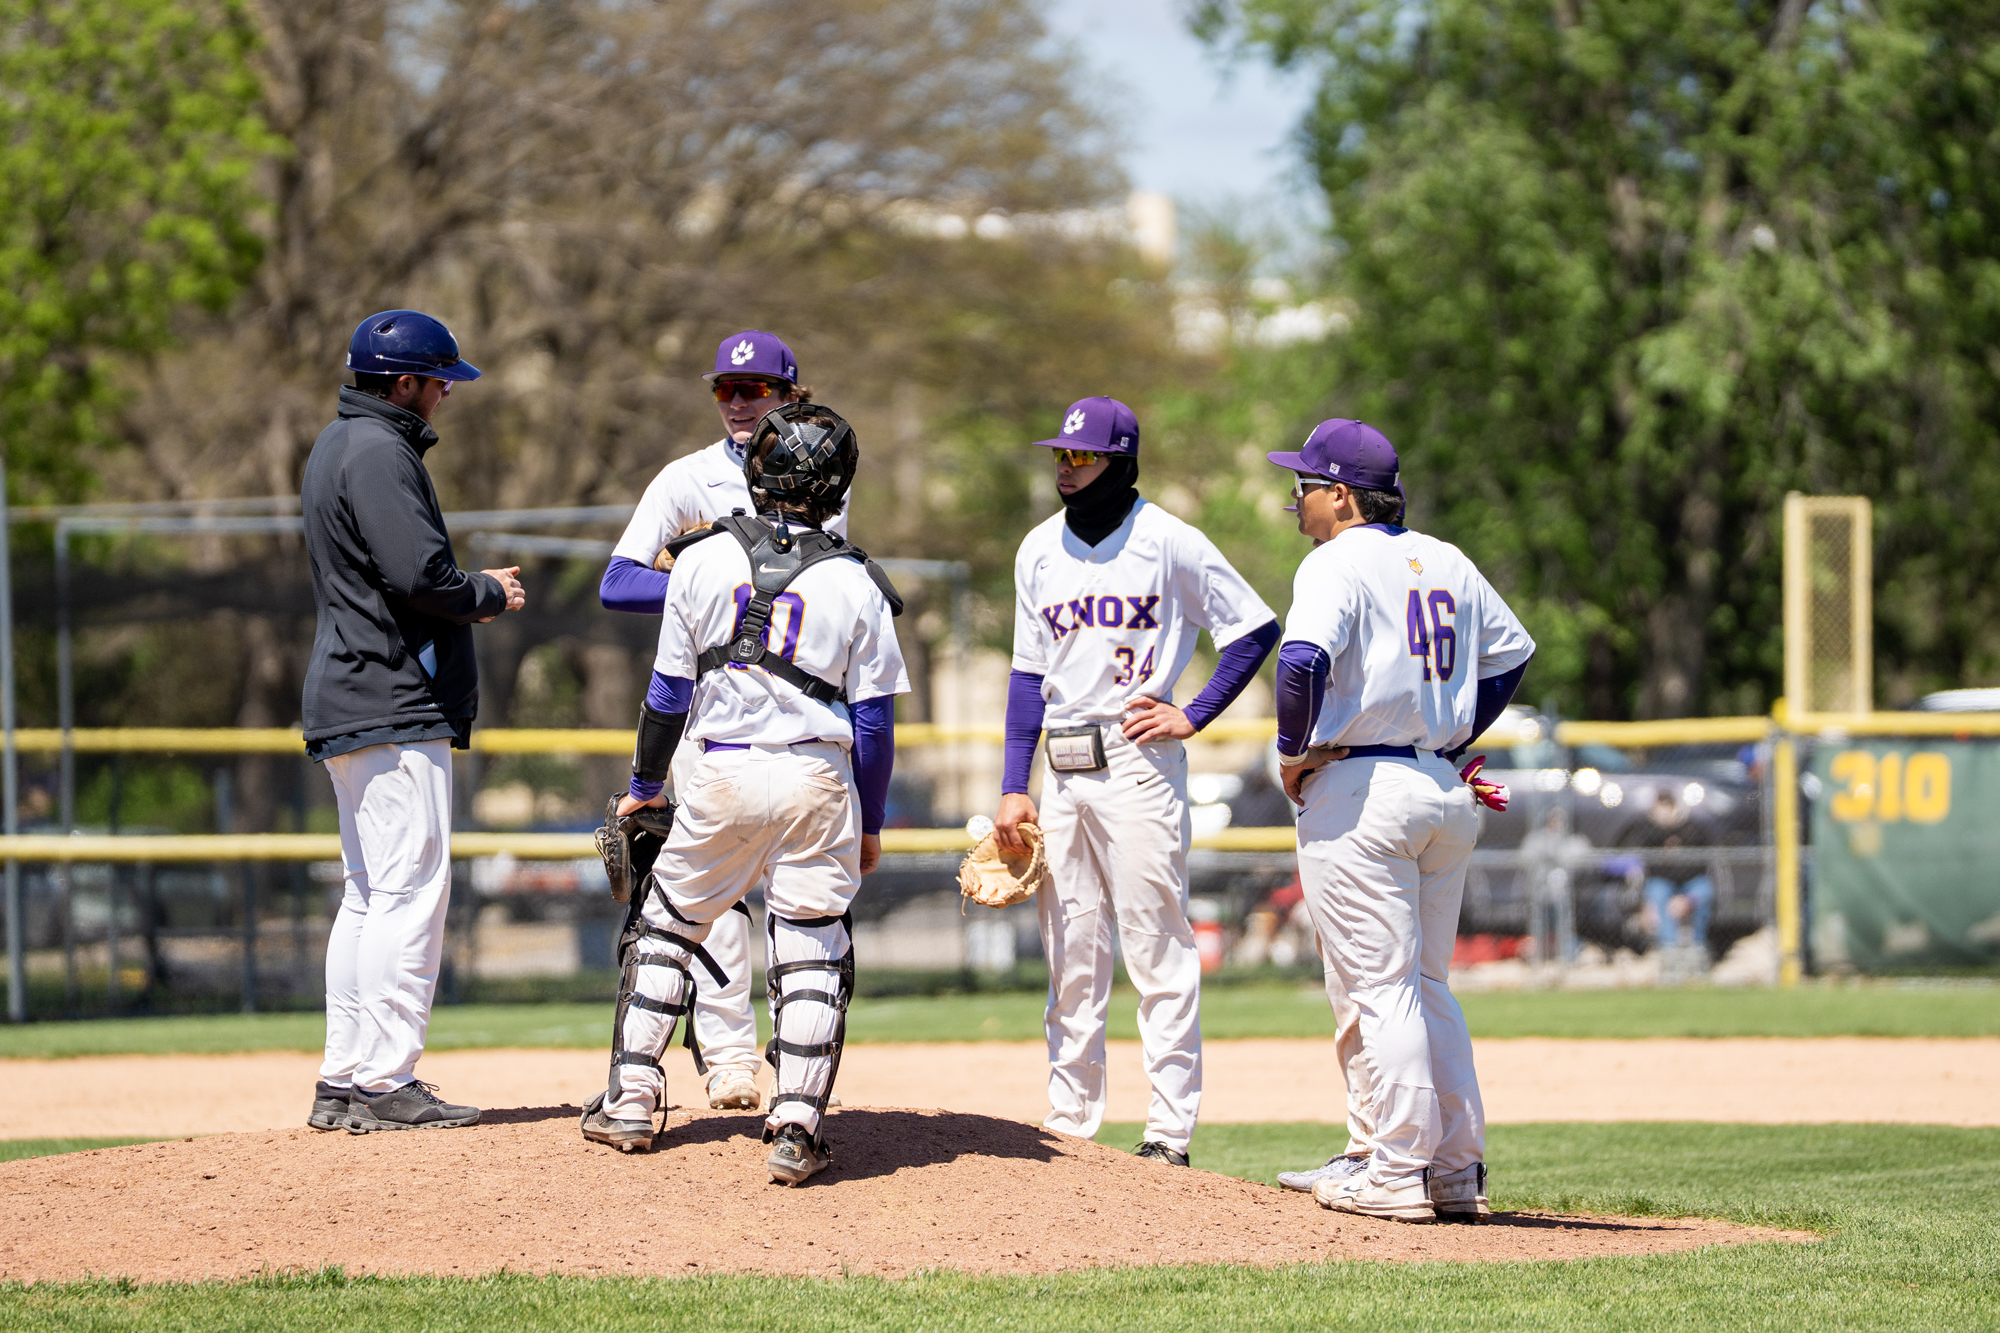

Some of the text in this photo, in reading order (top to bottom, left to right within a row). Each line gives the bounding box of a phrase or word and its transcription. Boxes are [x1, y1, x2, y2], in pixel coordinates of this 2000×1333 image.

[728, 581, 807, 679] 10
[1042, 594, 1161, 641] KNOX
[1406, 588, 1456, 682] 46
[1114, 645, 1156, 687] 34
[1831, 750, 1953, 825] 310
